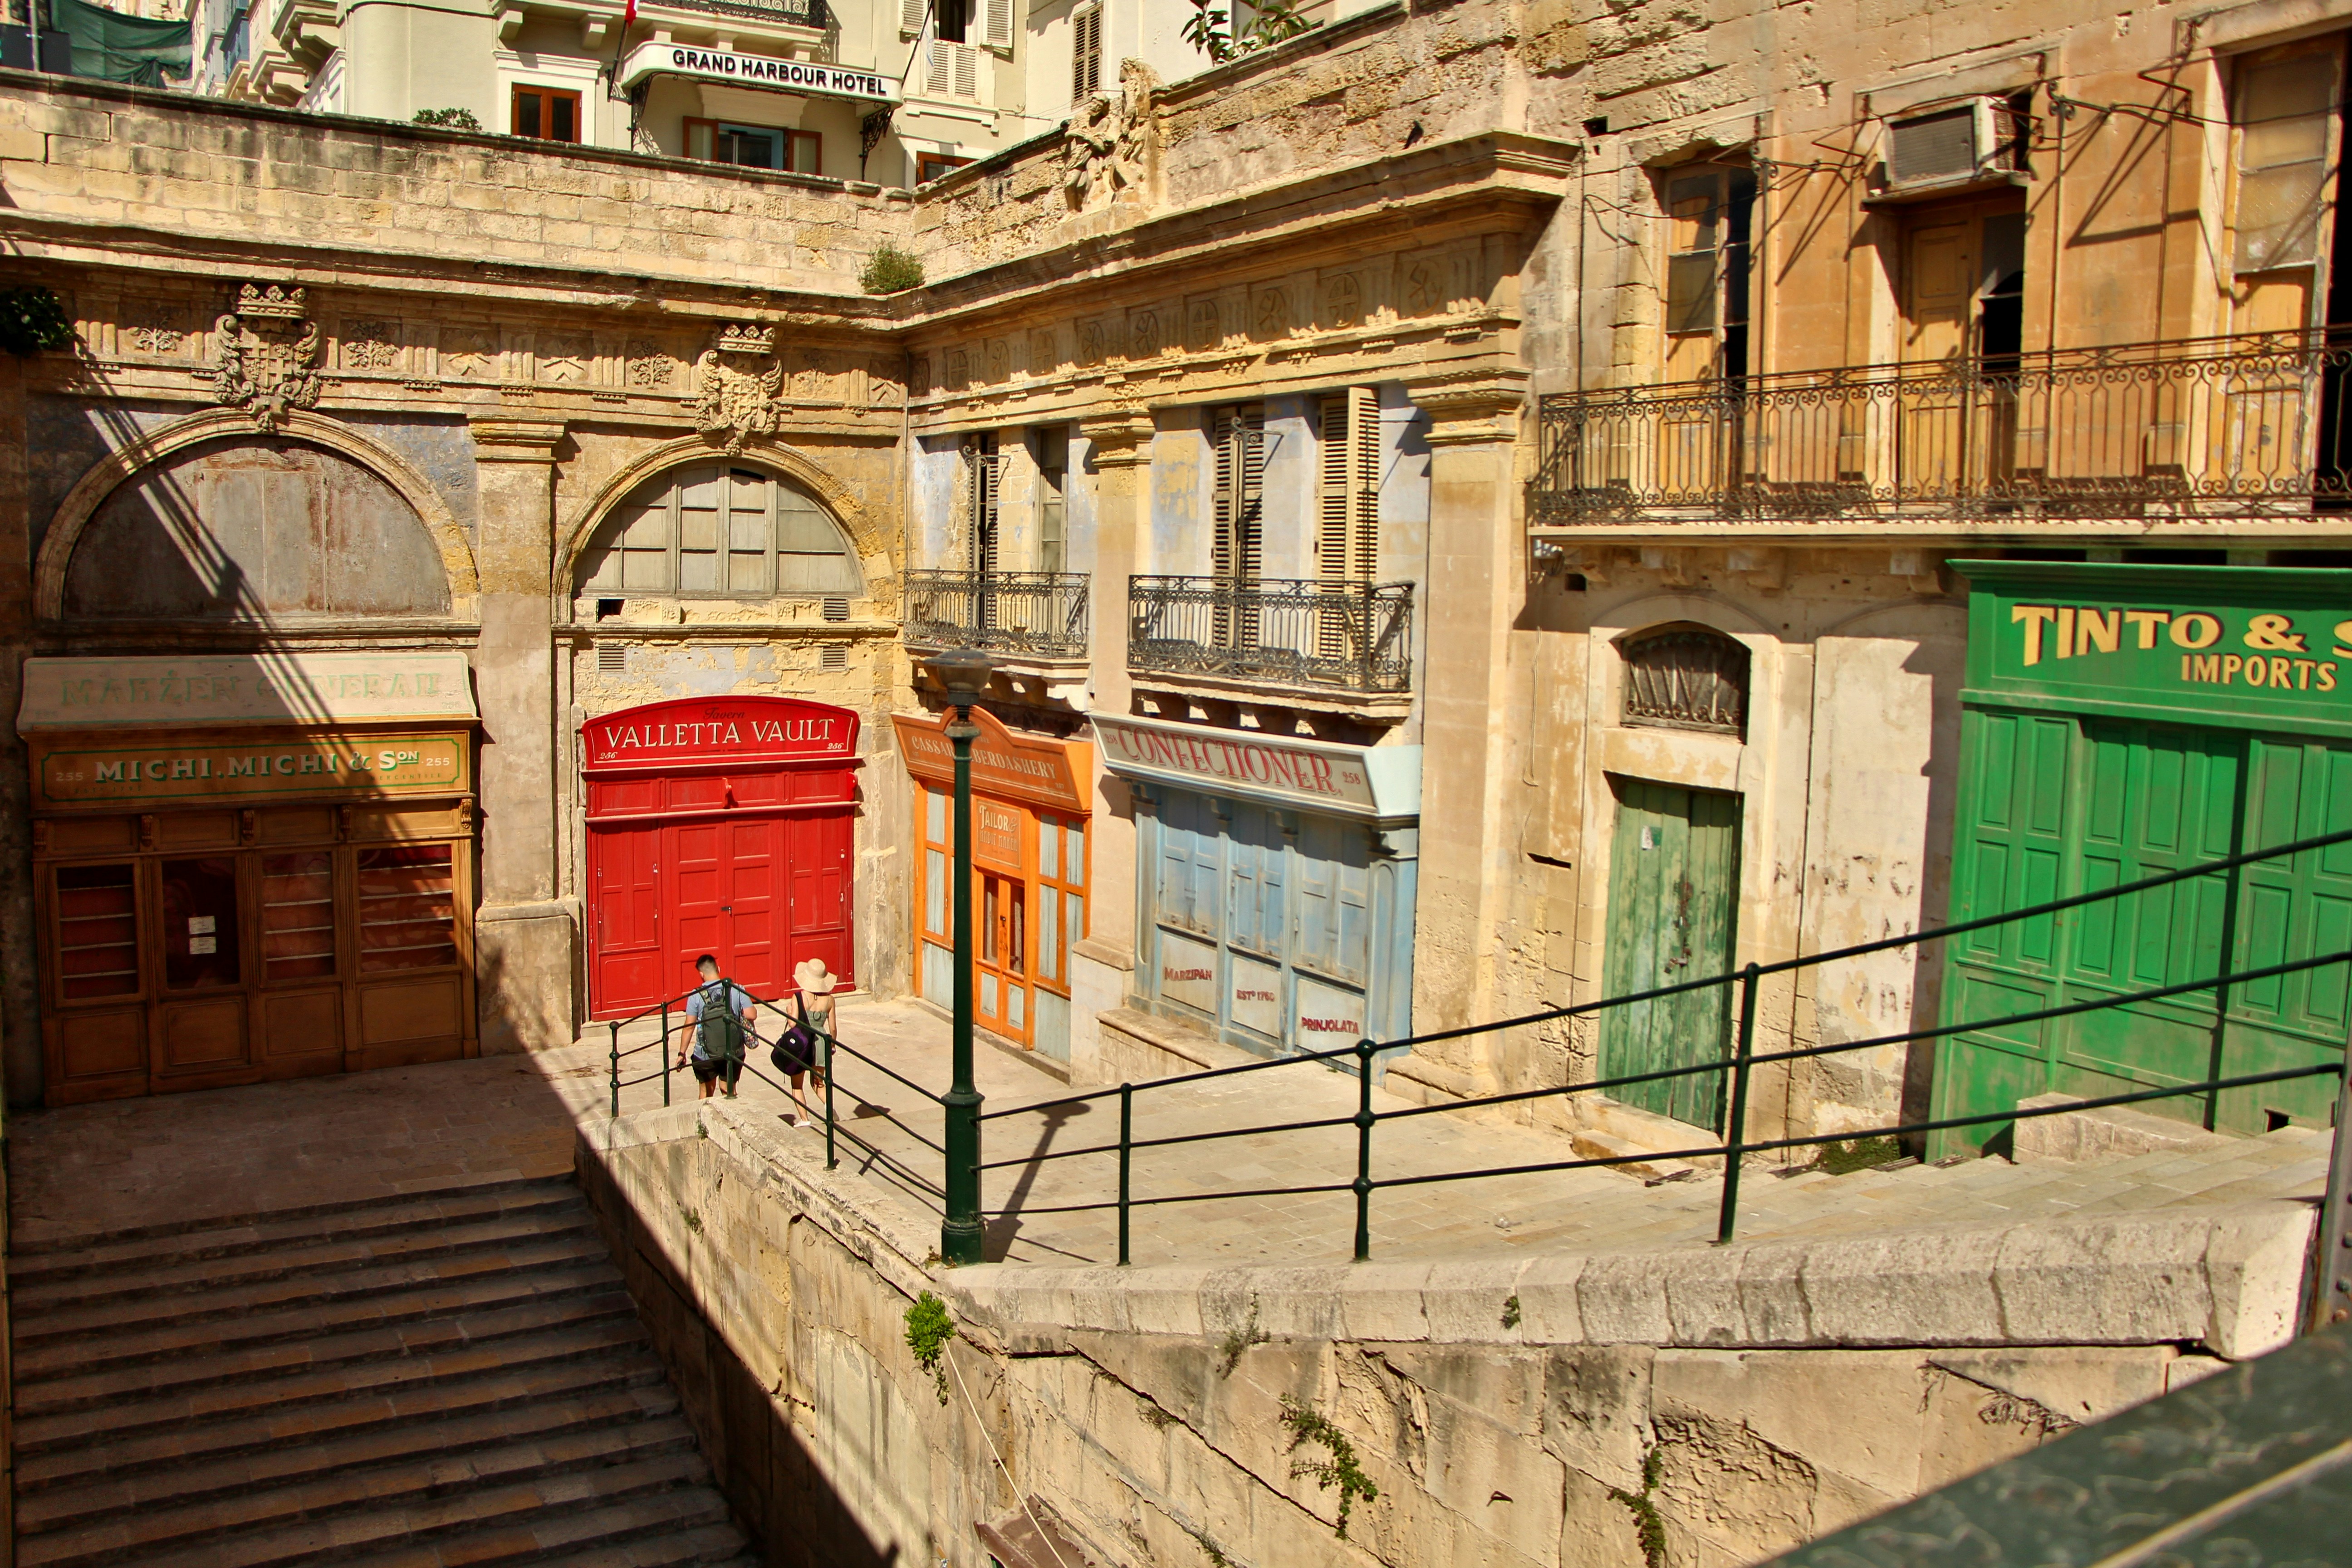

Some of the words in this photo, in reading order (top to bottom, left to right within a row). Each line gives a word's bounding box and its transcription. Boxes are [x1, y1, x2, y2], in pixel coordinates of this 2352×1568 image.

[673, 49, 736, 74] GRAND
[742, 59, 826, 87] HARBOUR
[833, 72, 887, 95] HOTEL
[2011, 602, 2225, 667] TINTO
[2243, 613, 2311, 653] &
[2181, 652, 2338, 692] IMPORTS
[703, 706, 745, 720] Tavern
[605, 722, 742, 748] VALLETTA
[751, 719, 835, 742] VAULT
[56, 772, 83, 781] 255
[348, 751, 371, 771] &
[426, 757, 450, 766] 255
[599, 751, 617, 760] 256
[912, 735, 955, 757] CASSAR
[971, 749, 1056, 779] BERDASHERY
[1104, 733, 1118, 745] 258
[1343, 771, 1361, 785] 258
[979, 804, 1009, 832] TAILOR
[1164, 966, 1213, 981] MARZIPAN
[1301, 1016, 1359, 1035] PRINJOLATA
